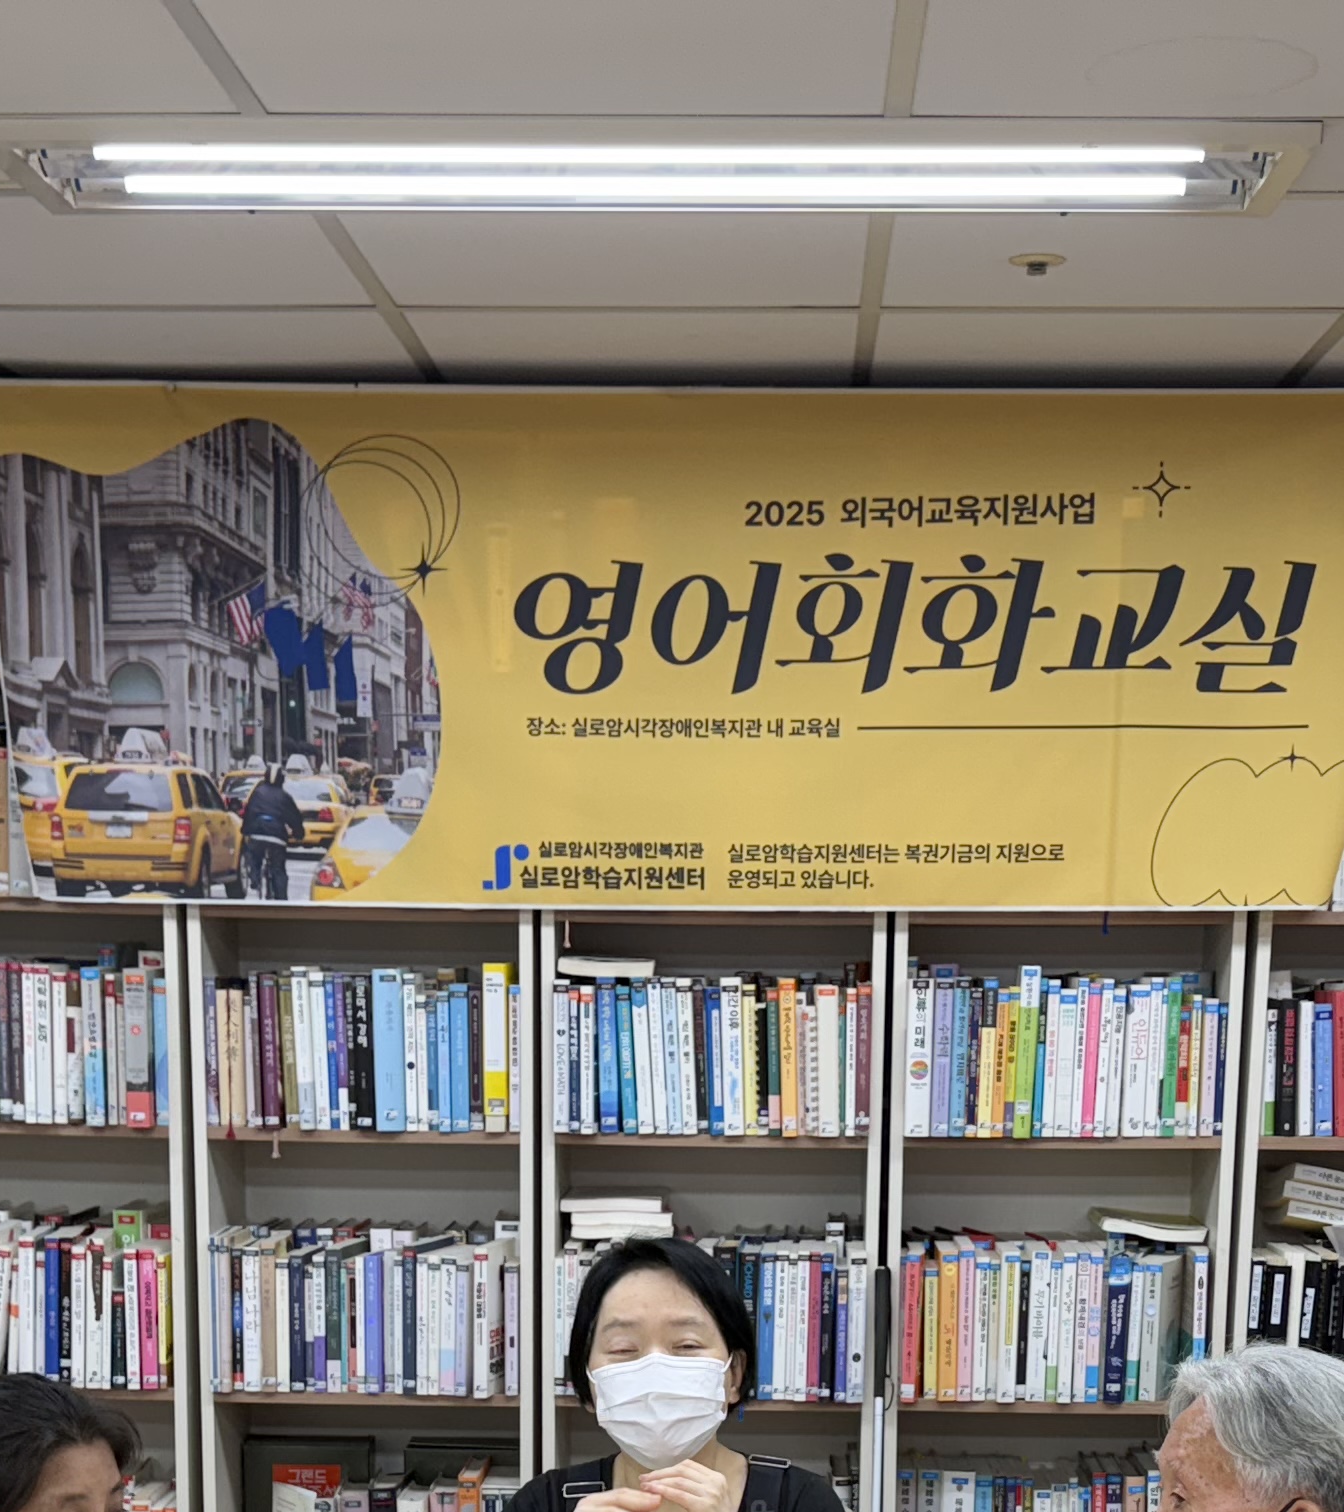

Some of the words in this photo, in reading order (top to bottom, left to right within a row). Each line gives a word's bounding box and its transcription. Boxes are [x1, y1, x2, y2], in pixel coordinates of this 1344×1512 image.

[745, 500, 826, 528] 2025
[840, 493, 1096, 528] 외국어교육지원사업
[513, 554, 1317, 696] 영어회화교실
[525, 718, 567, 738] 장소:
[571, 717, 762, 739] 실로암시각장애인복지관
[767, 717, 783, 738] 내
[788, 717, 842, 738] 교육실
[538, 841, 704, 859] 실로암시각장애인복지관
[728, 844, 900, 864] 실로암학습지원센터는
[904, 844, 990, 864] 복권기금의
[996, 844, 1064, 863] 지원으로
[520, 866, 705, 890] 실로암학습지원센터
[728, 870, 796, 889] 운영되고
[801, 870, 874, 889] 있습니다.
